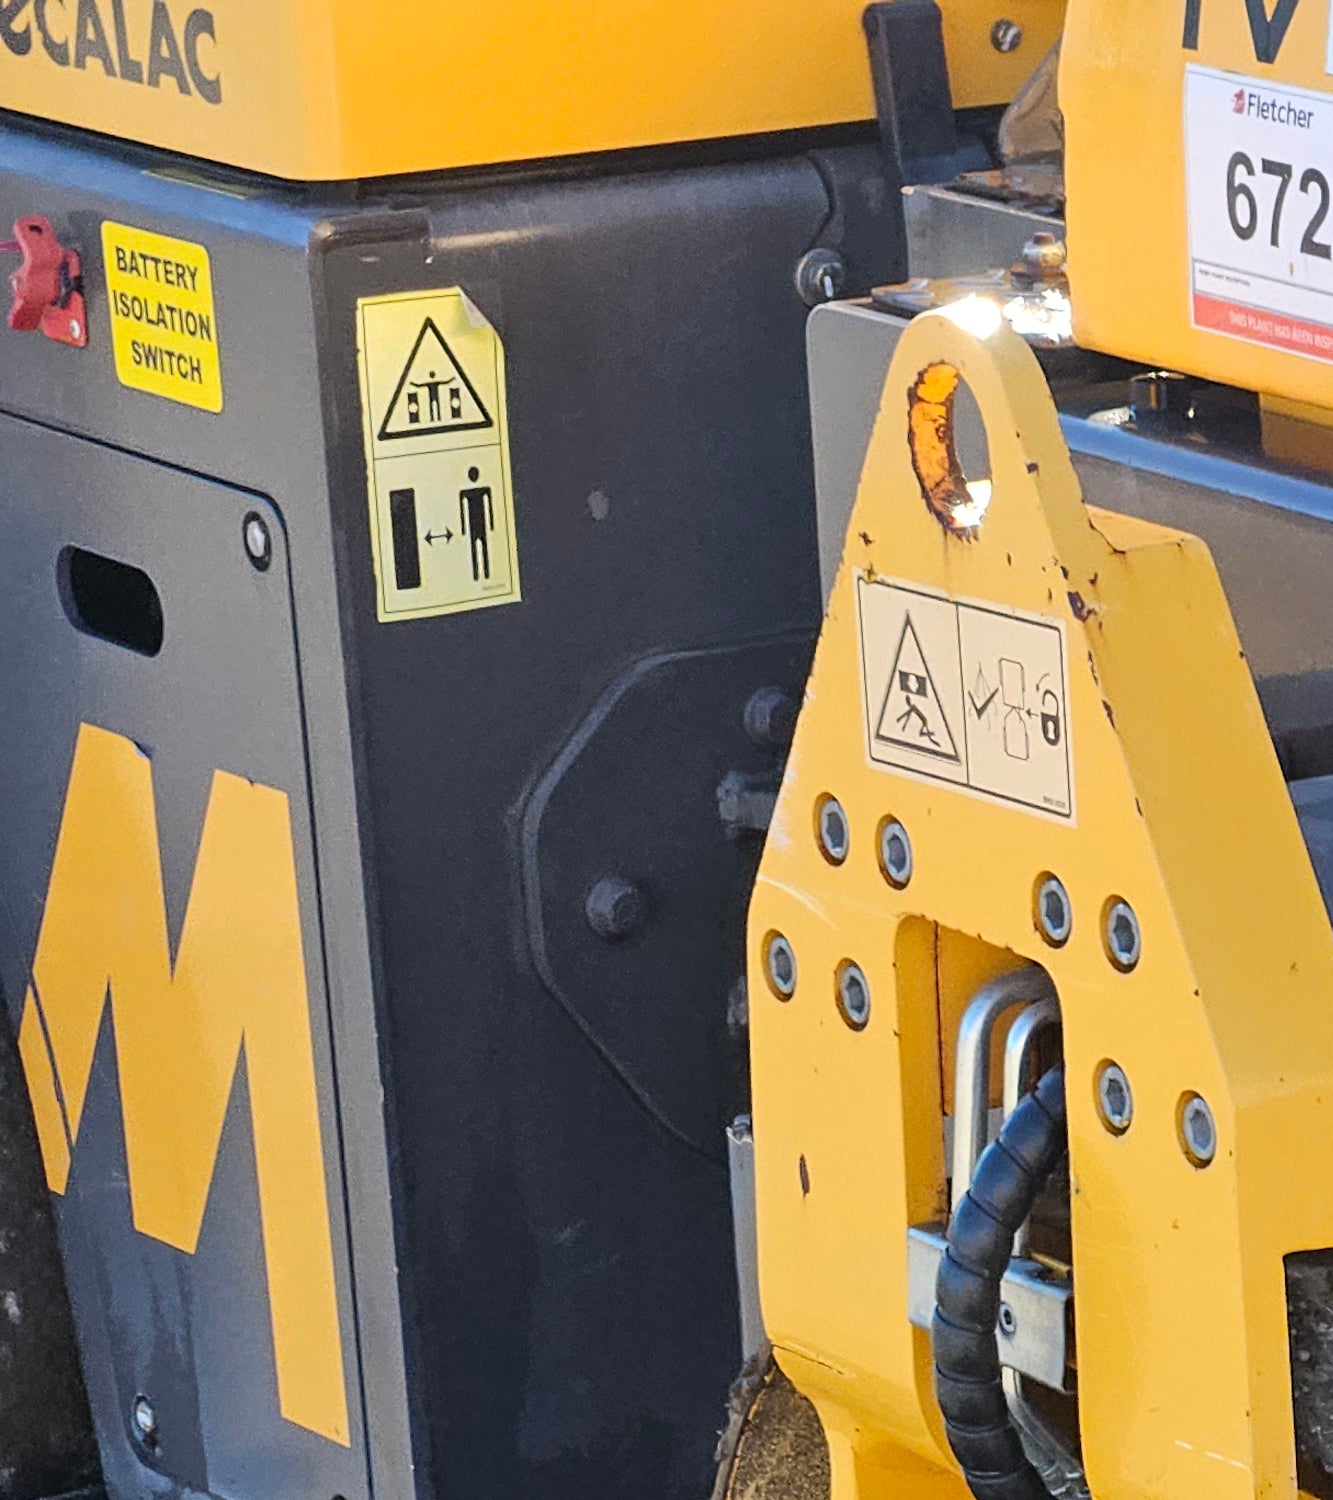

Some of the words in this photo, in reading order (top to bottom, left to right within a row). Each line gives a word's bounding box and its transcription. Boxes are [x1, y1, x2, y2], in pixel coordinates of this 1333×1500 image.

[1247, 93, 1314, 130] Fletcher
[1226, 151, 1332, 261] 672
[115, 246, 198, 292] BATTERY
[113, 289, 213, 342] ISOLATION
[1249, 314, 1273, 335] PLANT
[131, 339, 203, 384] SWITCH
